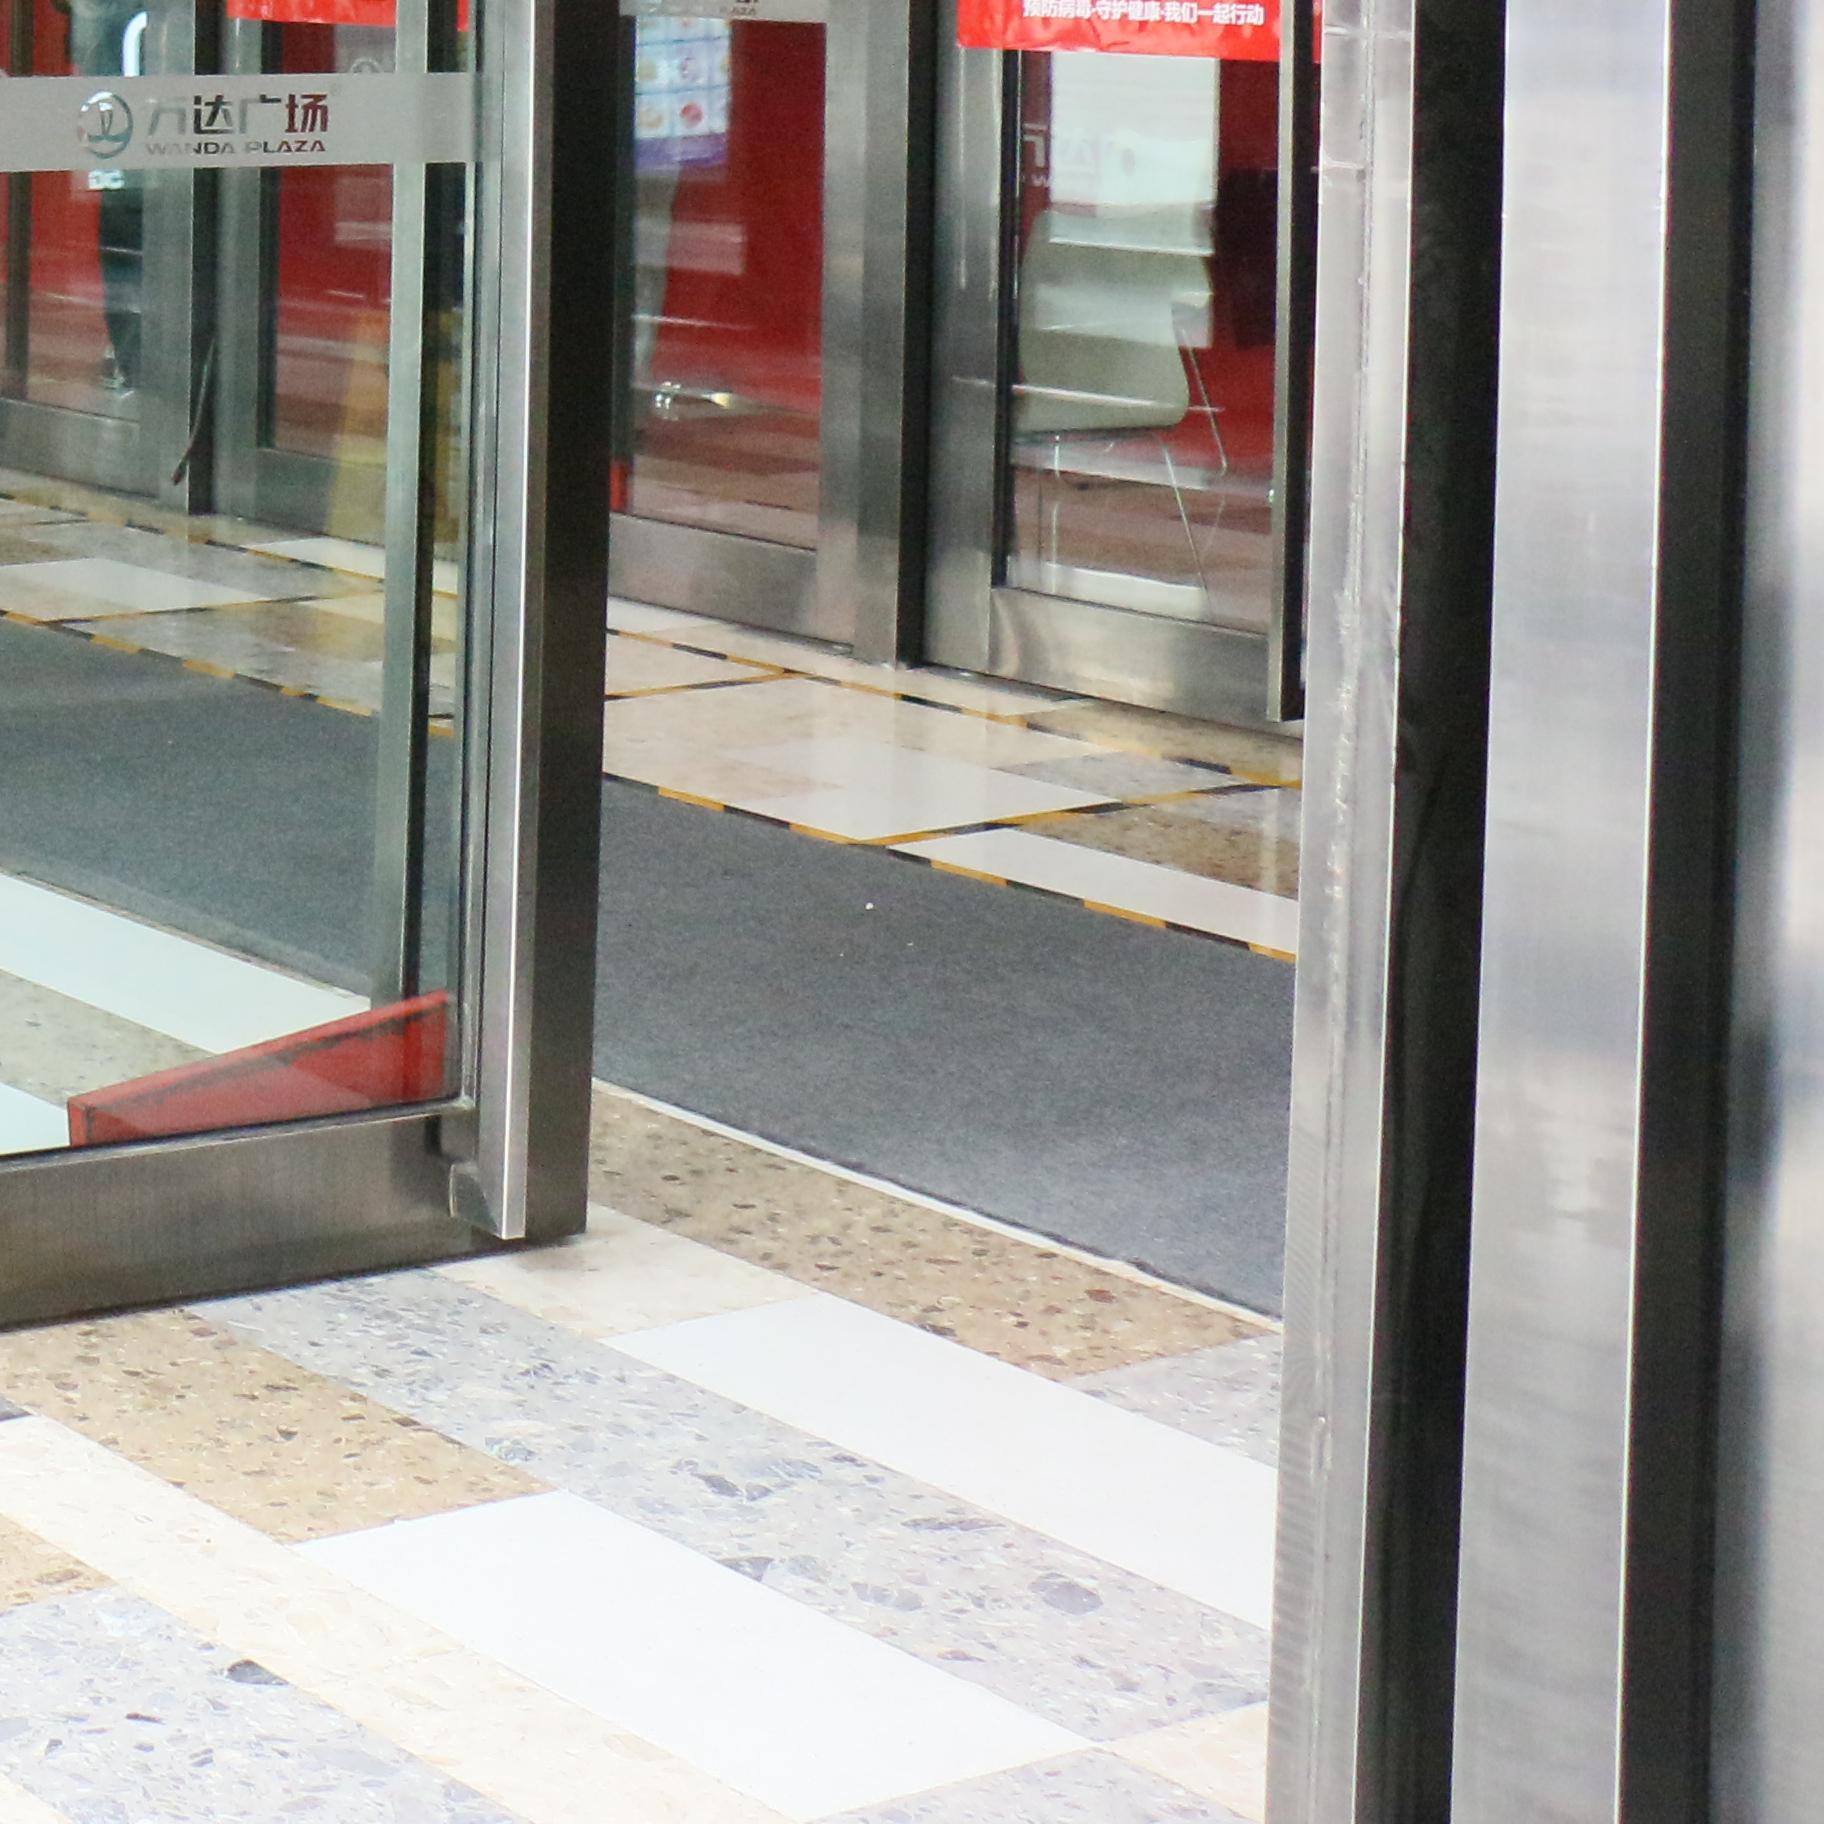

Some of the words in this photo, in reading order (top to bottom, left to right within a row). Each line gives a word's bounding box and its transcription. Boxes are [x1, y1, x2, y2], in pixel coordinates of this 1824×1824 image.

[148, 93, 329, 135] 万达广场
[145, 140, 236, 156] WANDA
[246, 139, 327, 154] PLAZA
